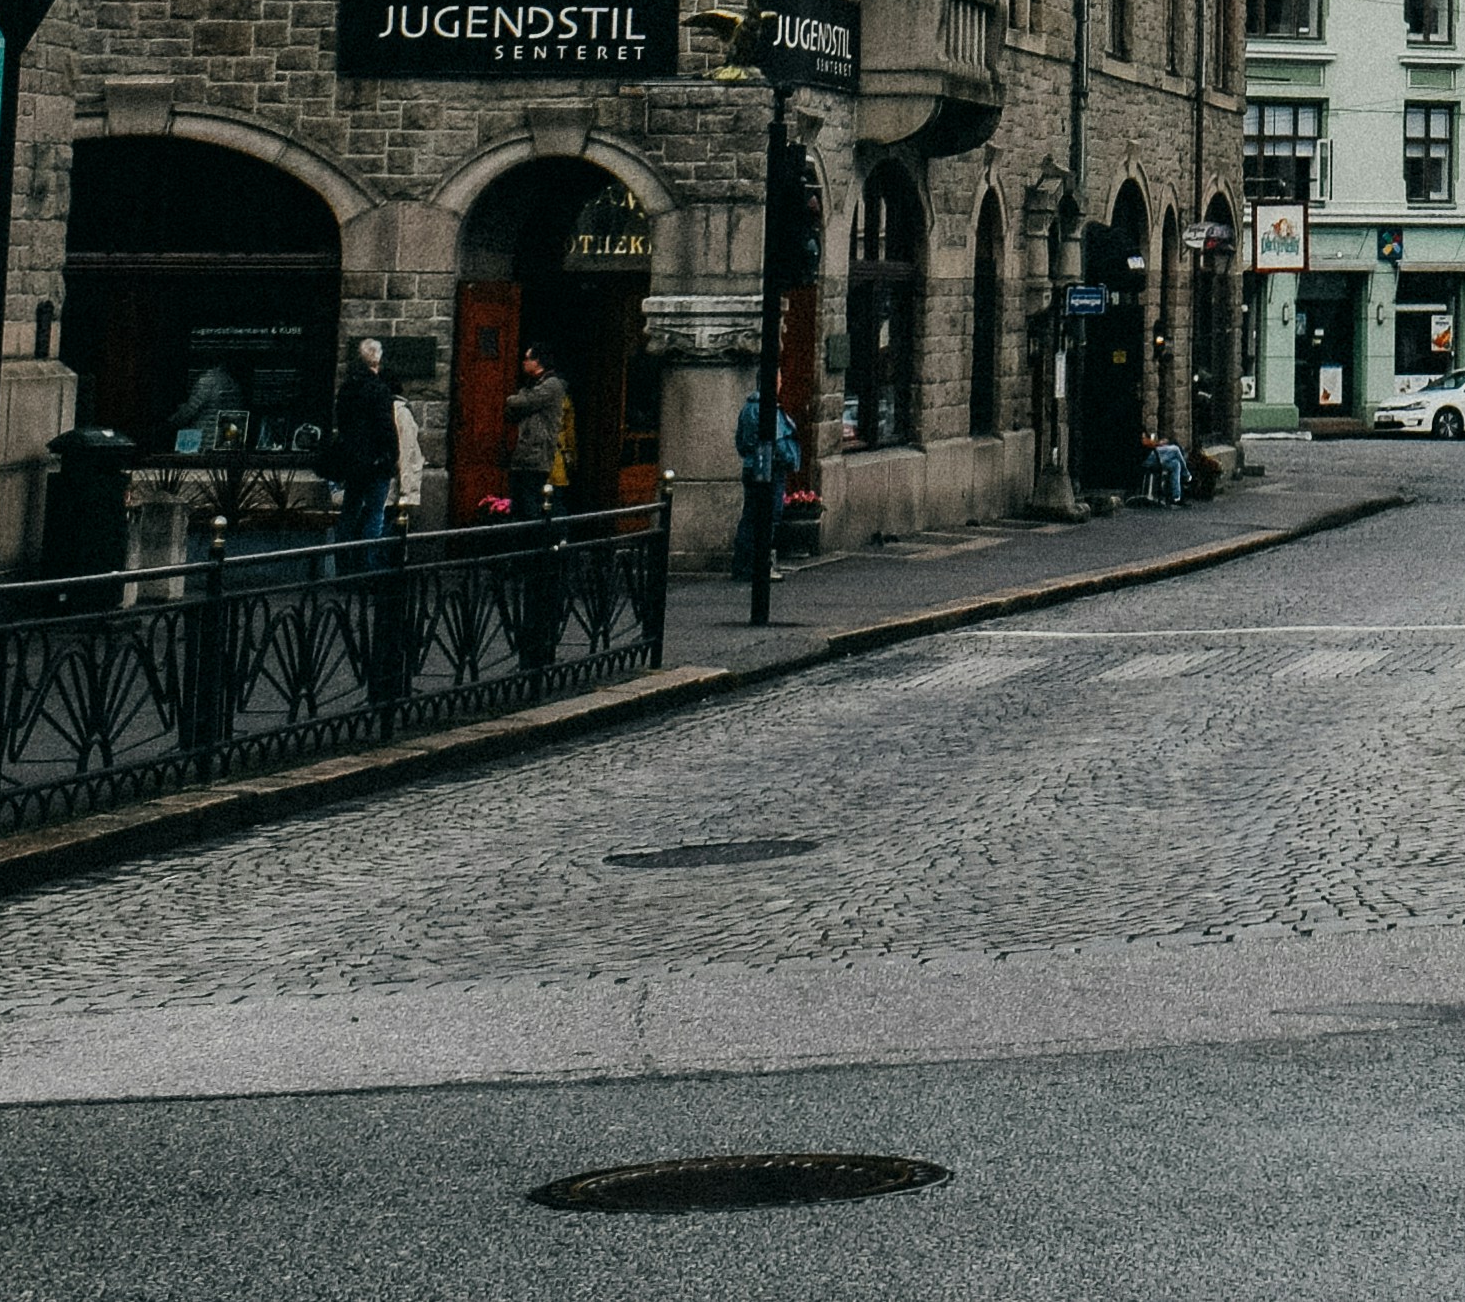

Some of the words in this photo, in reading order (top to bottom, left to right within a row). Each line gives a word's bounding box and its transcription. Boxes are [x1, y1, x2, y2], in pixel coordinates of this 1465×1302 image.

[378, 5, 646, 40] JUGENDSTIL
[772, 14, 852, 59] JUGENDSTIL
[494, 45, 646, 61] SENTERET
